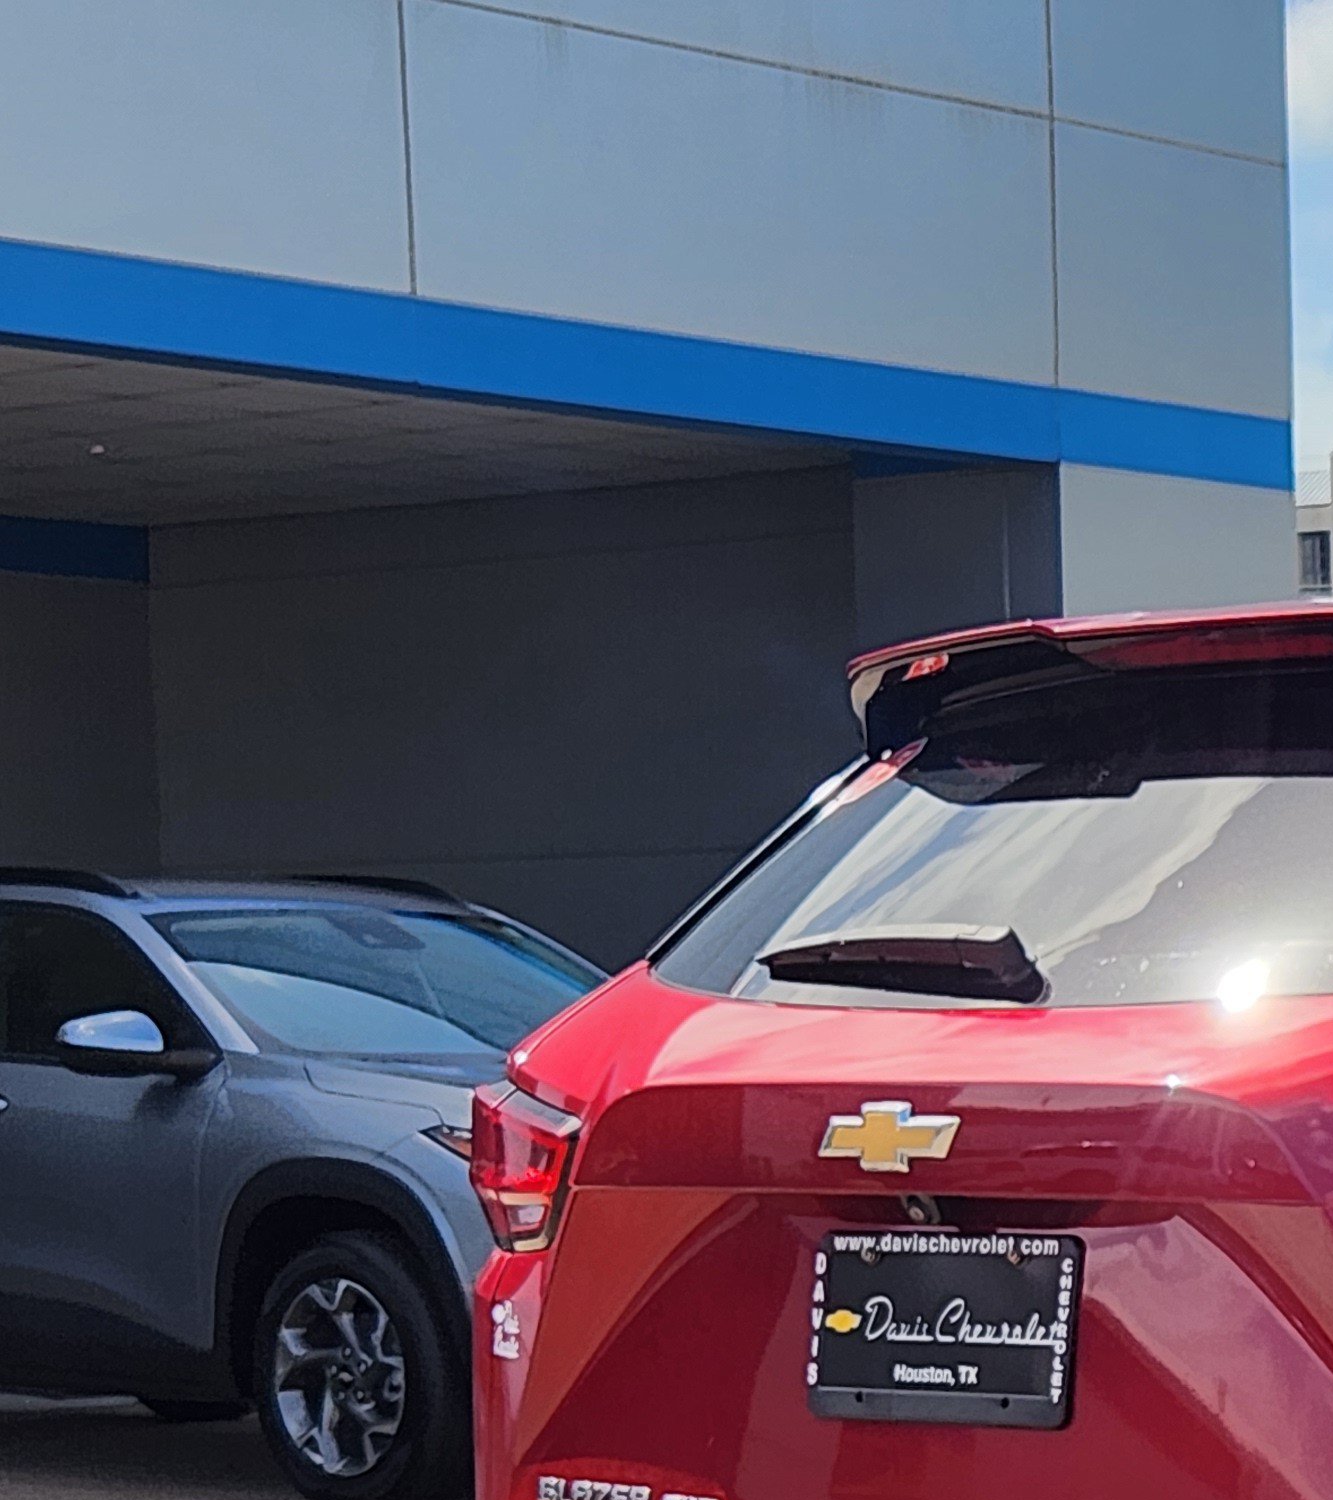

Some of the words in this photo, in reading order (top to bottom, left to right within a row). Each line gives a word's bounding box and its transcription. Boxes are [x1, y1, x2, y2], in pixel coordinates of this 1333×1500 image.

[833, 1232, 1059, 1256] www.davischevroletcom
[807, 1251, 827, 1386] DAVIS
[864, 1295, 935, 1342] Davis
[935, 1297, 1063, 1345] Chevrolet
[1049, 1257, 1074, 1405] CHEVROLET
[893, 1363, 956, 1387] Houston,
[958, 1364, 979, 1385] TX
